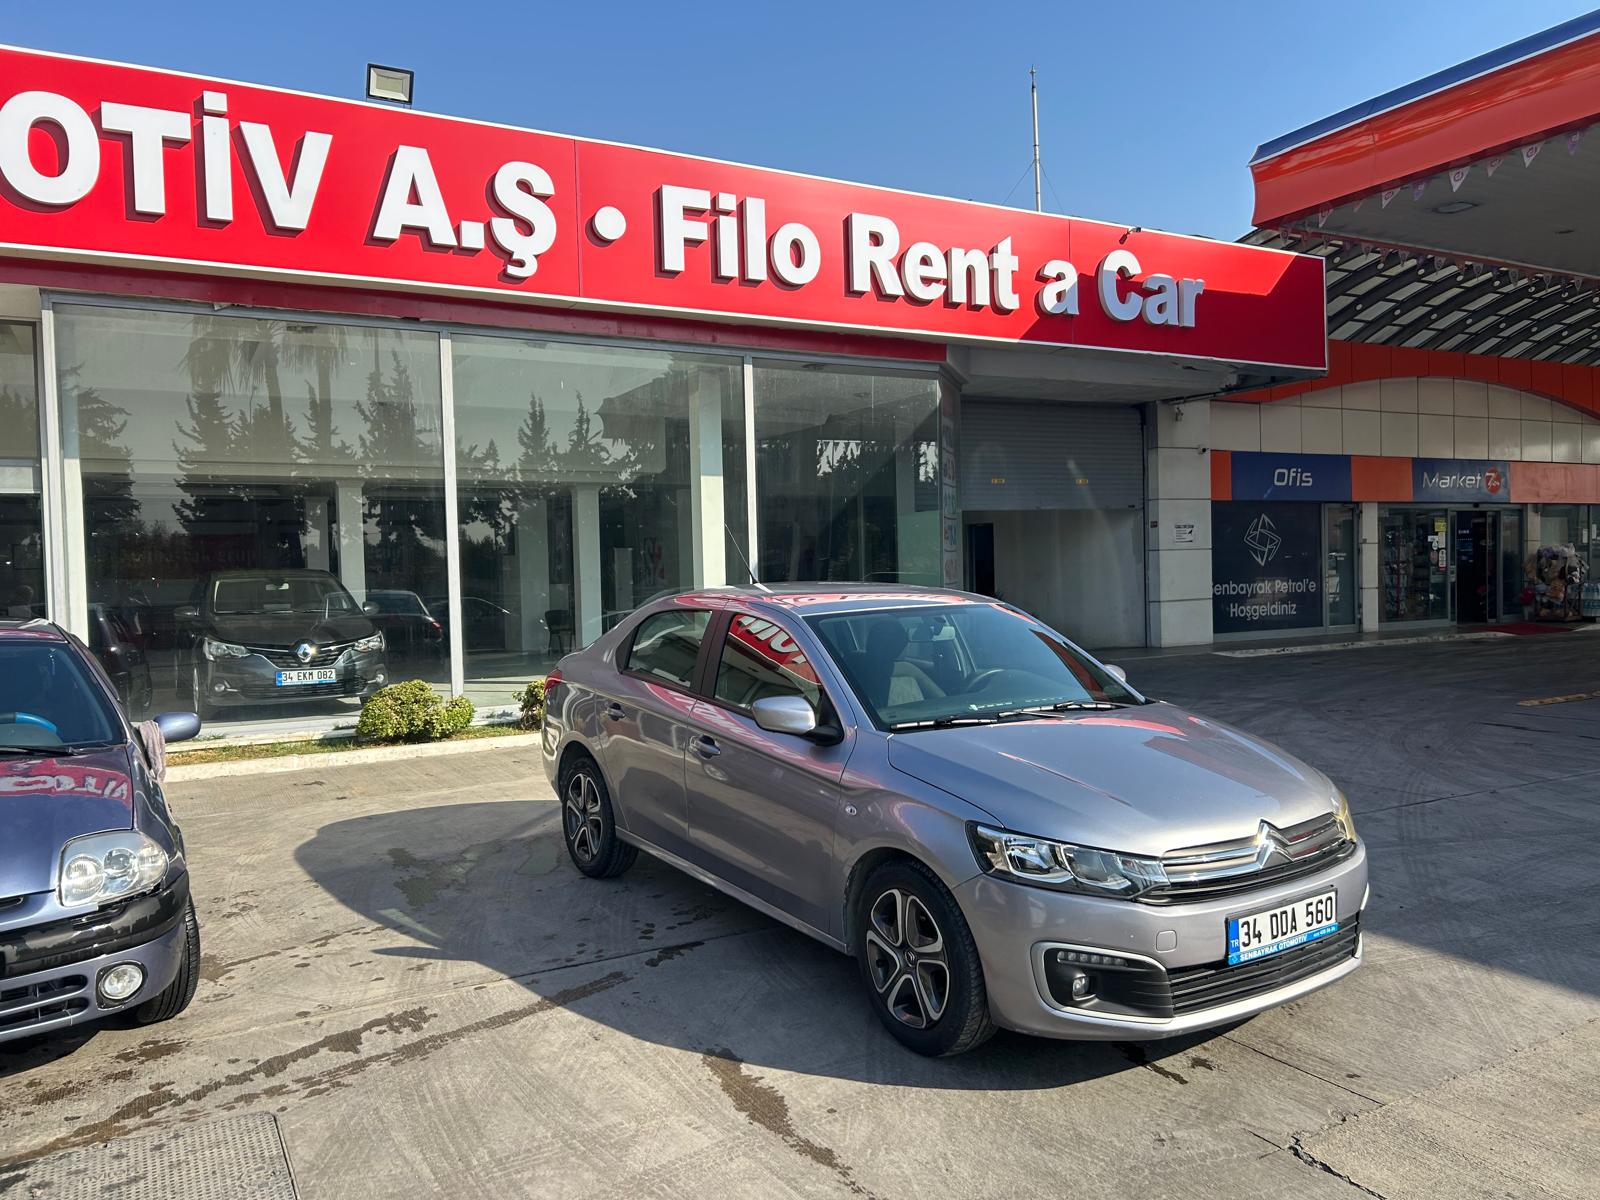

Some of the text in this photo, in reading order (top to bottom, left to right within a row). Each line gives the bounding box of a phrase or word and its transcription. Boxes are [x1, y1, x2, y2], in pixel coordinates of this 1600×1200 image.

[0, 89, 334, 230] OTİV
[658, 184, 822, 286] Filo
[848, 212, 1020, 311] Rent
[1038, 259, 1080, 316] a
[1098, 249, 1206, 327] Car
[1274, 467, 1313, 487] Ofis
[1421, 471, 1482, 488] Market
[1230, 601, 1297, 620] Hoşgeldiniz
[282, 670, 333, 681] 34 EKM 082
[1240, 896, 1334, 947] 34 DDA 560
[1231, 939, 1240, 948] TR
